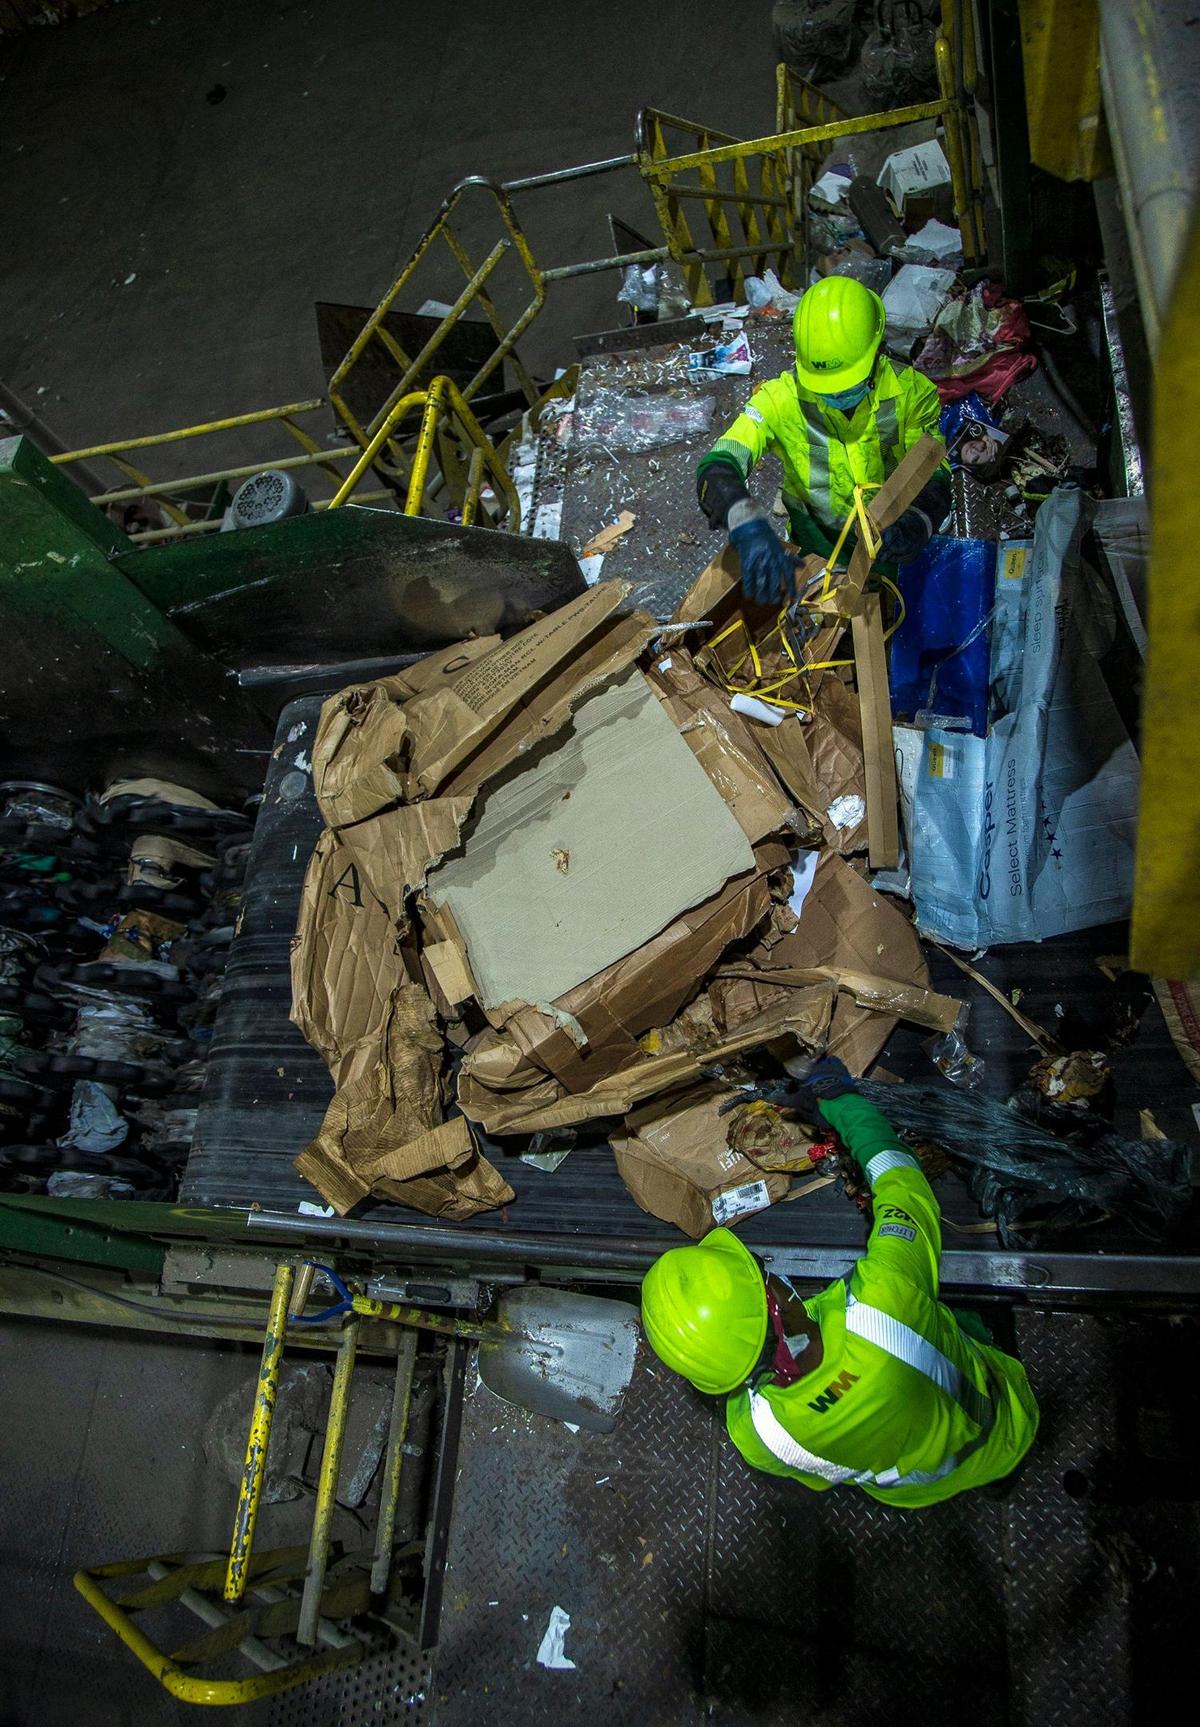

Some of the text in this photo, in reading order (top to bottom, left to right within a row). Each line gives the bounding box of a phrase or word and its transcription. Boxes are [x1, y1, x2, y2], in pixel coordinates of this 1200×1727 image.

[811, 360, 843, 369] WM
[1031, 612, 1043, 654] sleep
[979, 781, 996, 900] Casper
[1006, 759, 1022, 896] Select Mattress
[807, 1369, 861, 1413] WM
